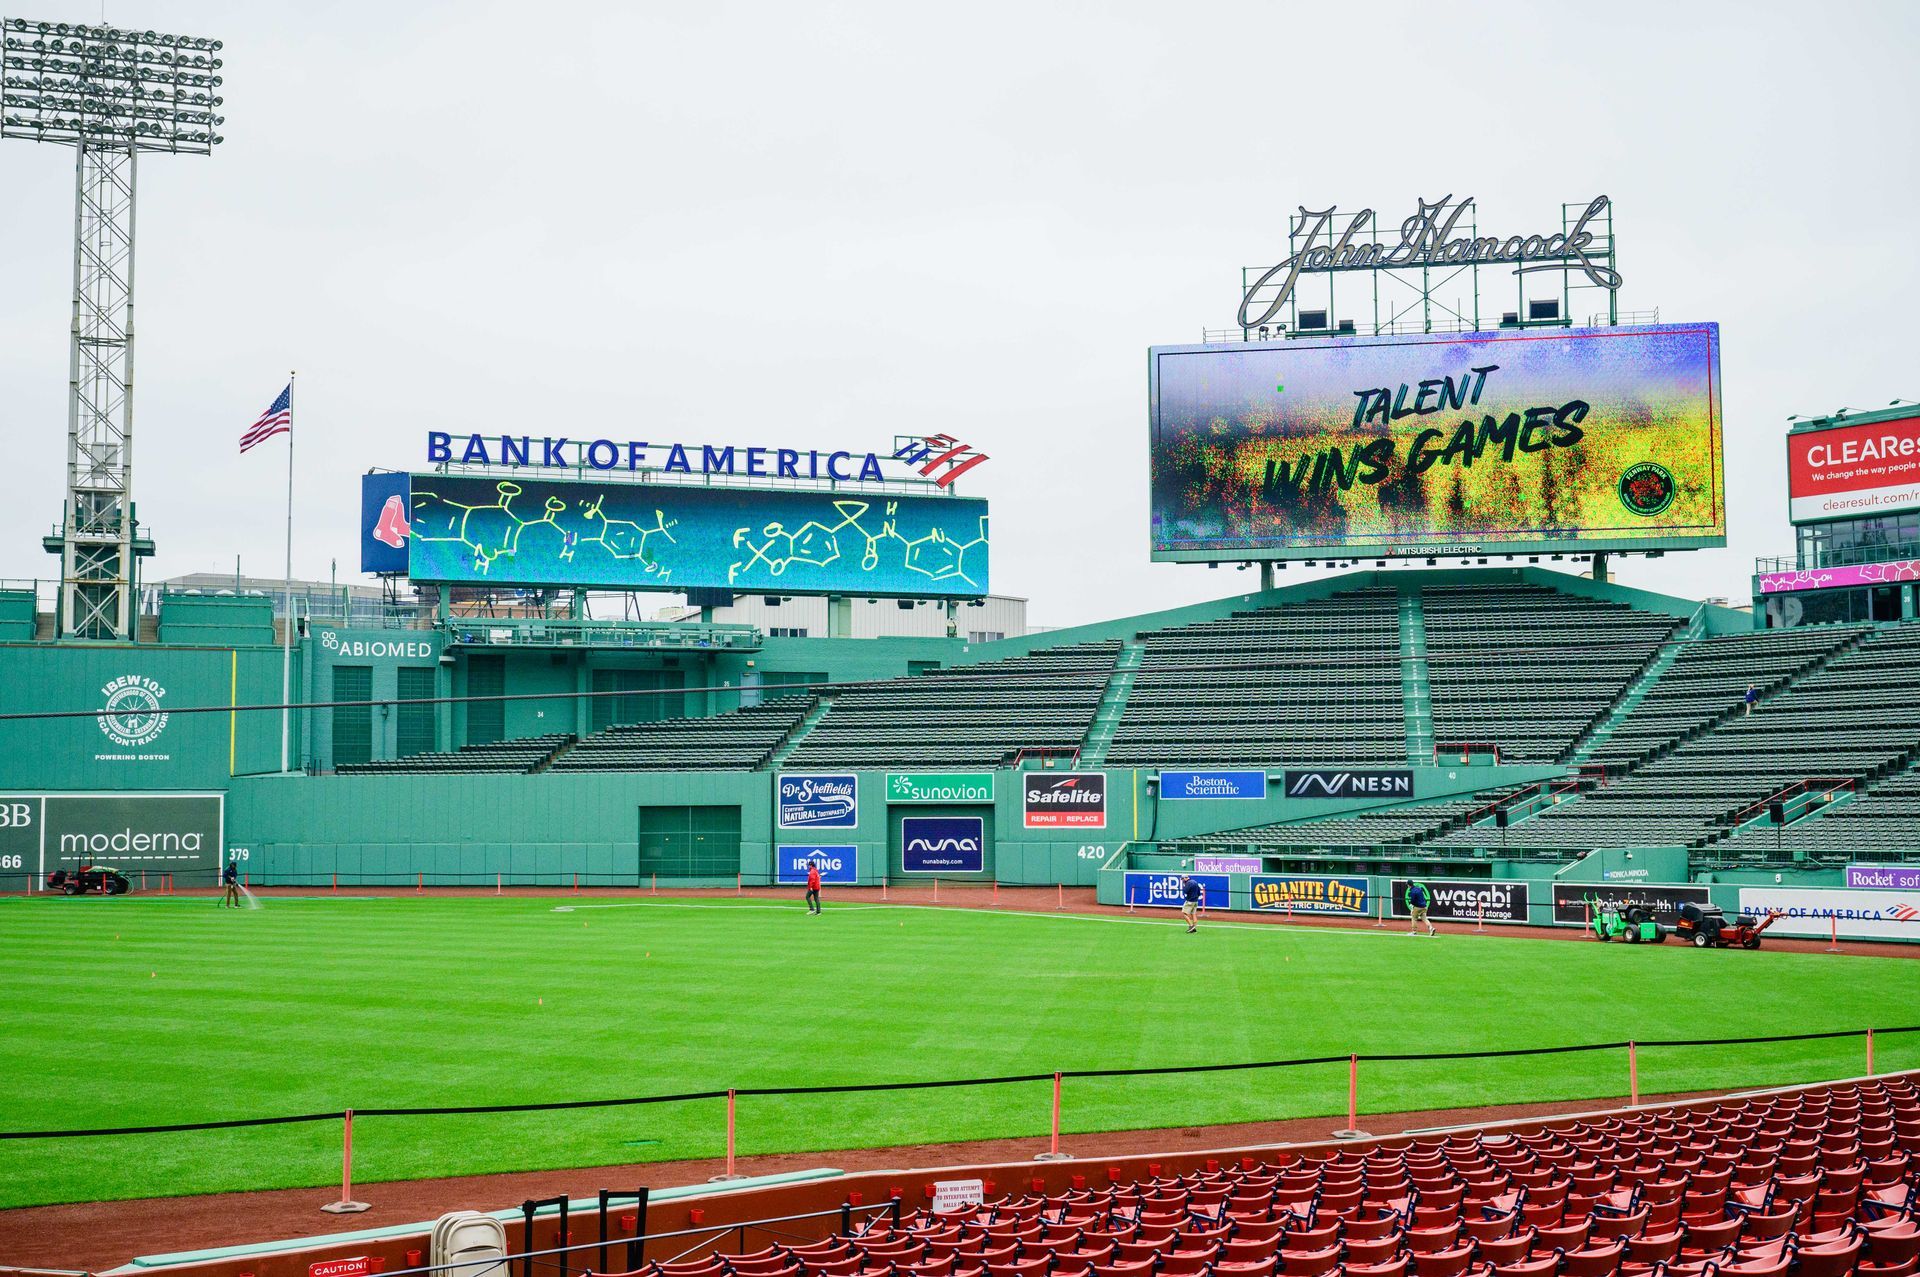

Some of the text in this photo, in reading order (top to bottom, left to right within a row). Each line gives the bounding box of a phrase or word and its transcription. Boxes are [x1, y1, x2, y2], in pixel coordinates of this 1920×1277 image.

[1238, 193, 1623, 329] John Hancock
[1353, 364, 1500, 428] TALENT
[428, 430, 885, 483] BANK OF AMERICA
[1263, 399, 1590, 502] WINS GAMES
[1626, 465, 1668, 480] FENWAY PARK
[1812, 461, 1916, 481] We change the way people
[1398, 545, 1481, 555] MITSUBISHI ELECTRIC
[339, 642, 431, 657] ABIOMED
[101, 675, 166, 698] IBEW 103
[1193, 776, 1227, 786] Boston
[1448, 772, 1456, 780] 40
[782, 783, 799, 798] Dr.
[911, 784, 987, 799] sunovion
[1185, 782, 1240, 795] Scientific
[1352, 777, 1409, 792] NESN
[1027, 789, 1101, 804] Safelite
[784, 809, 817, 822] NATURAL
[61, 827, 200, 851] moderna
[907, 837, 978, 851] nuna
[229, 848, 249, 861] 379
[1077, 845, 1105, 859] 420
[0, 855, 22, 868] 66
[922, 857, 963, 866] nunababy.com
[1198, 861, 1258, 873] Rocket software
[1852, 871, 1893, 886] Rocket
[1148, 876, 1203, 903] jetBl
[1254, 879, 1366, 909] GRANITE CITY
[1433, 885, 1510, 909] wasabi
[1274, 901, 1344, 910] ELECTRIC SUPPLY
[1453, 907, 1512, 920] hot cloud storage
[1788, 907, 1807, 918] OF
[1811, 908, 1882, 921] AMERICA
[314, 1262, 367, 1276] CAUTION!
